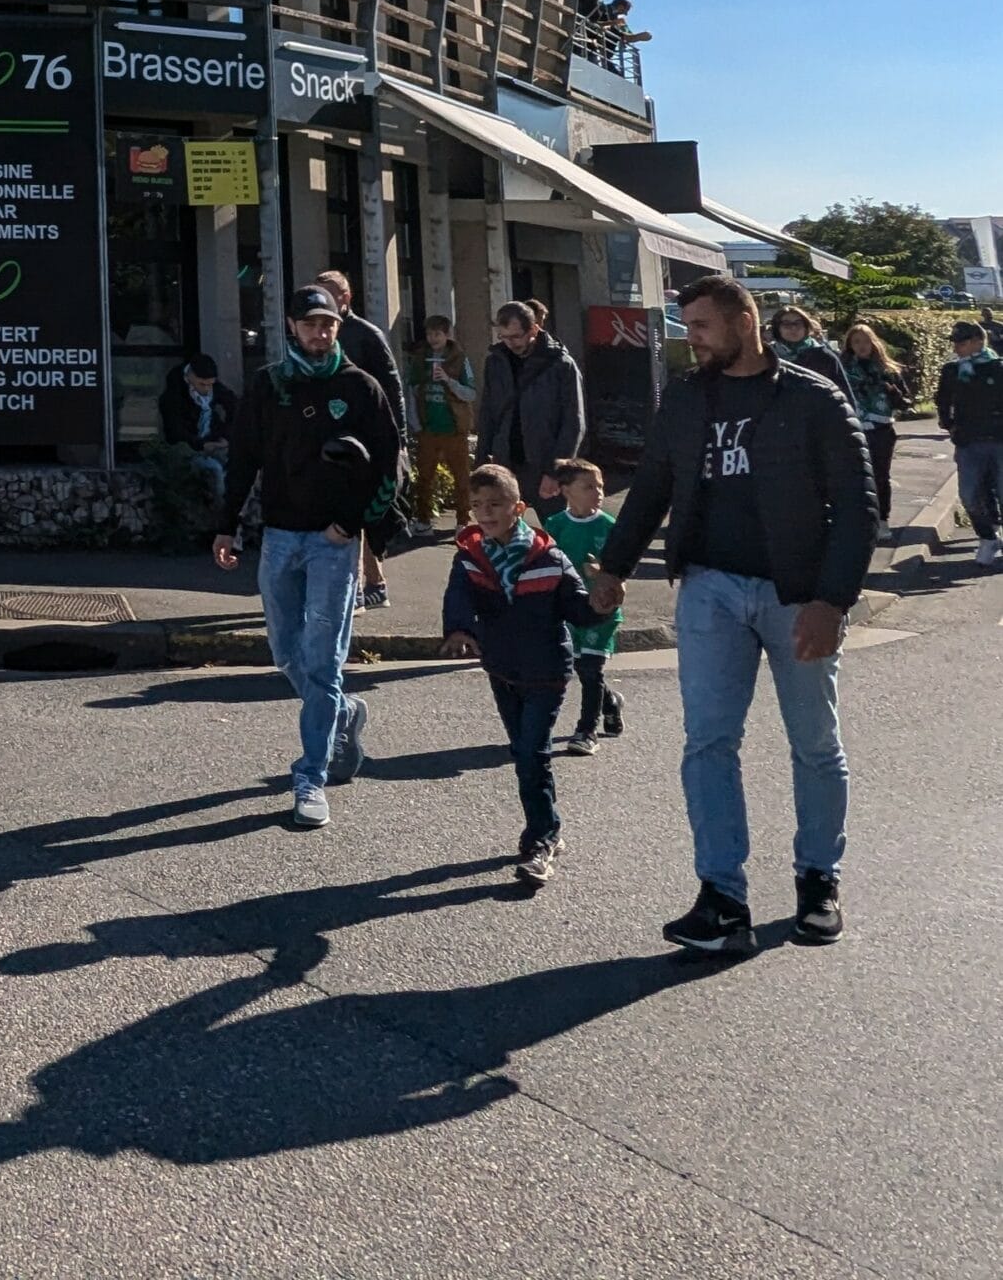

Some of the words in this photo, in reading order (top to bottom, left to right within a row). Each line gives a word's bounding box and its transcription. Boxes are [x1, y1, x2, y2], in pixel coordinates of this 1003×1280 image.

[103, 41, 266, 90] Brasserie
[290, 62, 357, 105] Snack
[11, 371, 66, 387] JOUR
[71, 371, 97, 387] DE
